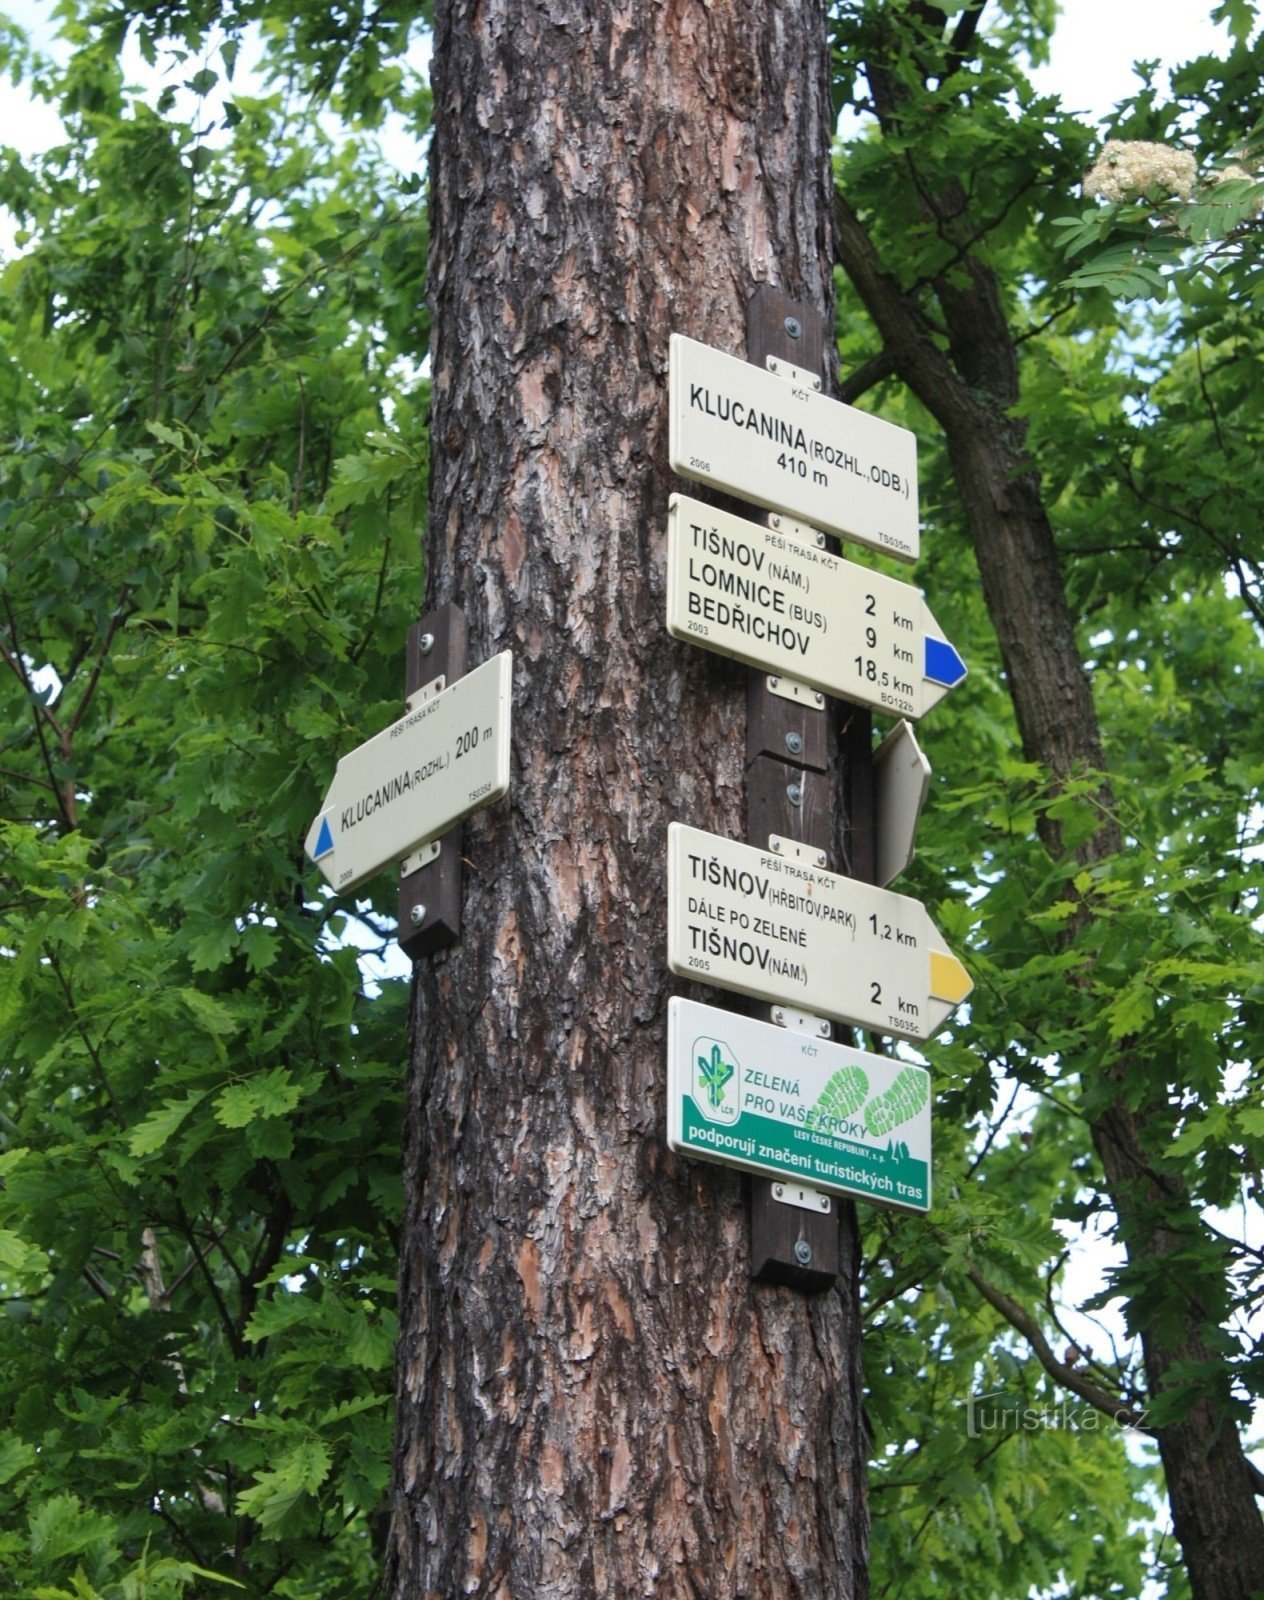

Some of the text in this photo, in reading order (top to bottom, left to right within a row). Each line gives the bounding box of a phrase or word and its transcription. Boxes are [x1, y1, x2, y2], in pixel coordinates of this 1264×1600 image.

[690, 384, 807, 454] KLUCANINA
[690, 456, 710, 472] 2006
[777, 453, 828, 486] 410 m
[788, 544, 819, 563] TRASA
[821, 557, 839, 571] KČT
[878, 532, 912, 552] TS035m
[690, 524, 810, 594] TIŠNOV (NÁM.)
[689, 558, 827, 633] LOMNICE (BUS)
[688, 591, 810, 655] BEDŘICHOV
[688, 621, 709, 636] 2003
[865, 594, 913, 631] 2 km
[866, 628, 913, 664] 9 km
[893, 677, 913, 696] km
[455, 726, 478, 759] 200
[483, 727, 492, 741] m
[761, 858, 836, 889] PĚŠÍ TRASA KČT
[688, 897, 807, 947] DÁLE PO ZELENÉ
[896, 928, 916, 947] km
[688, 956, 710, 971] 2005
[870, 982, 919, 1016] 2 km
[888, 1016, 919, 1034] TS035c
[801, 1044, 818, 1057] KČT
[744, 1068, 800, 1097] ZELENÁ
[744, 1093, 868, 1139] PRO VAŠE KROKY
[794, 1130, 810, 1141] LESY
[812, 1132, 833, 1148] ČESKÉ
[689, 1124, 923, 1200] podporují značení turistických tras
